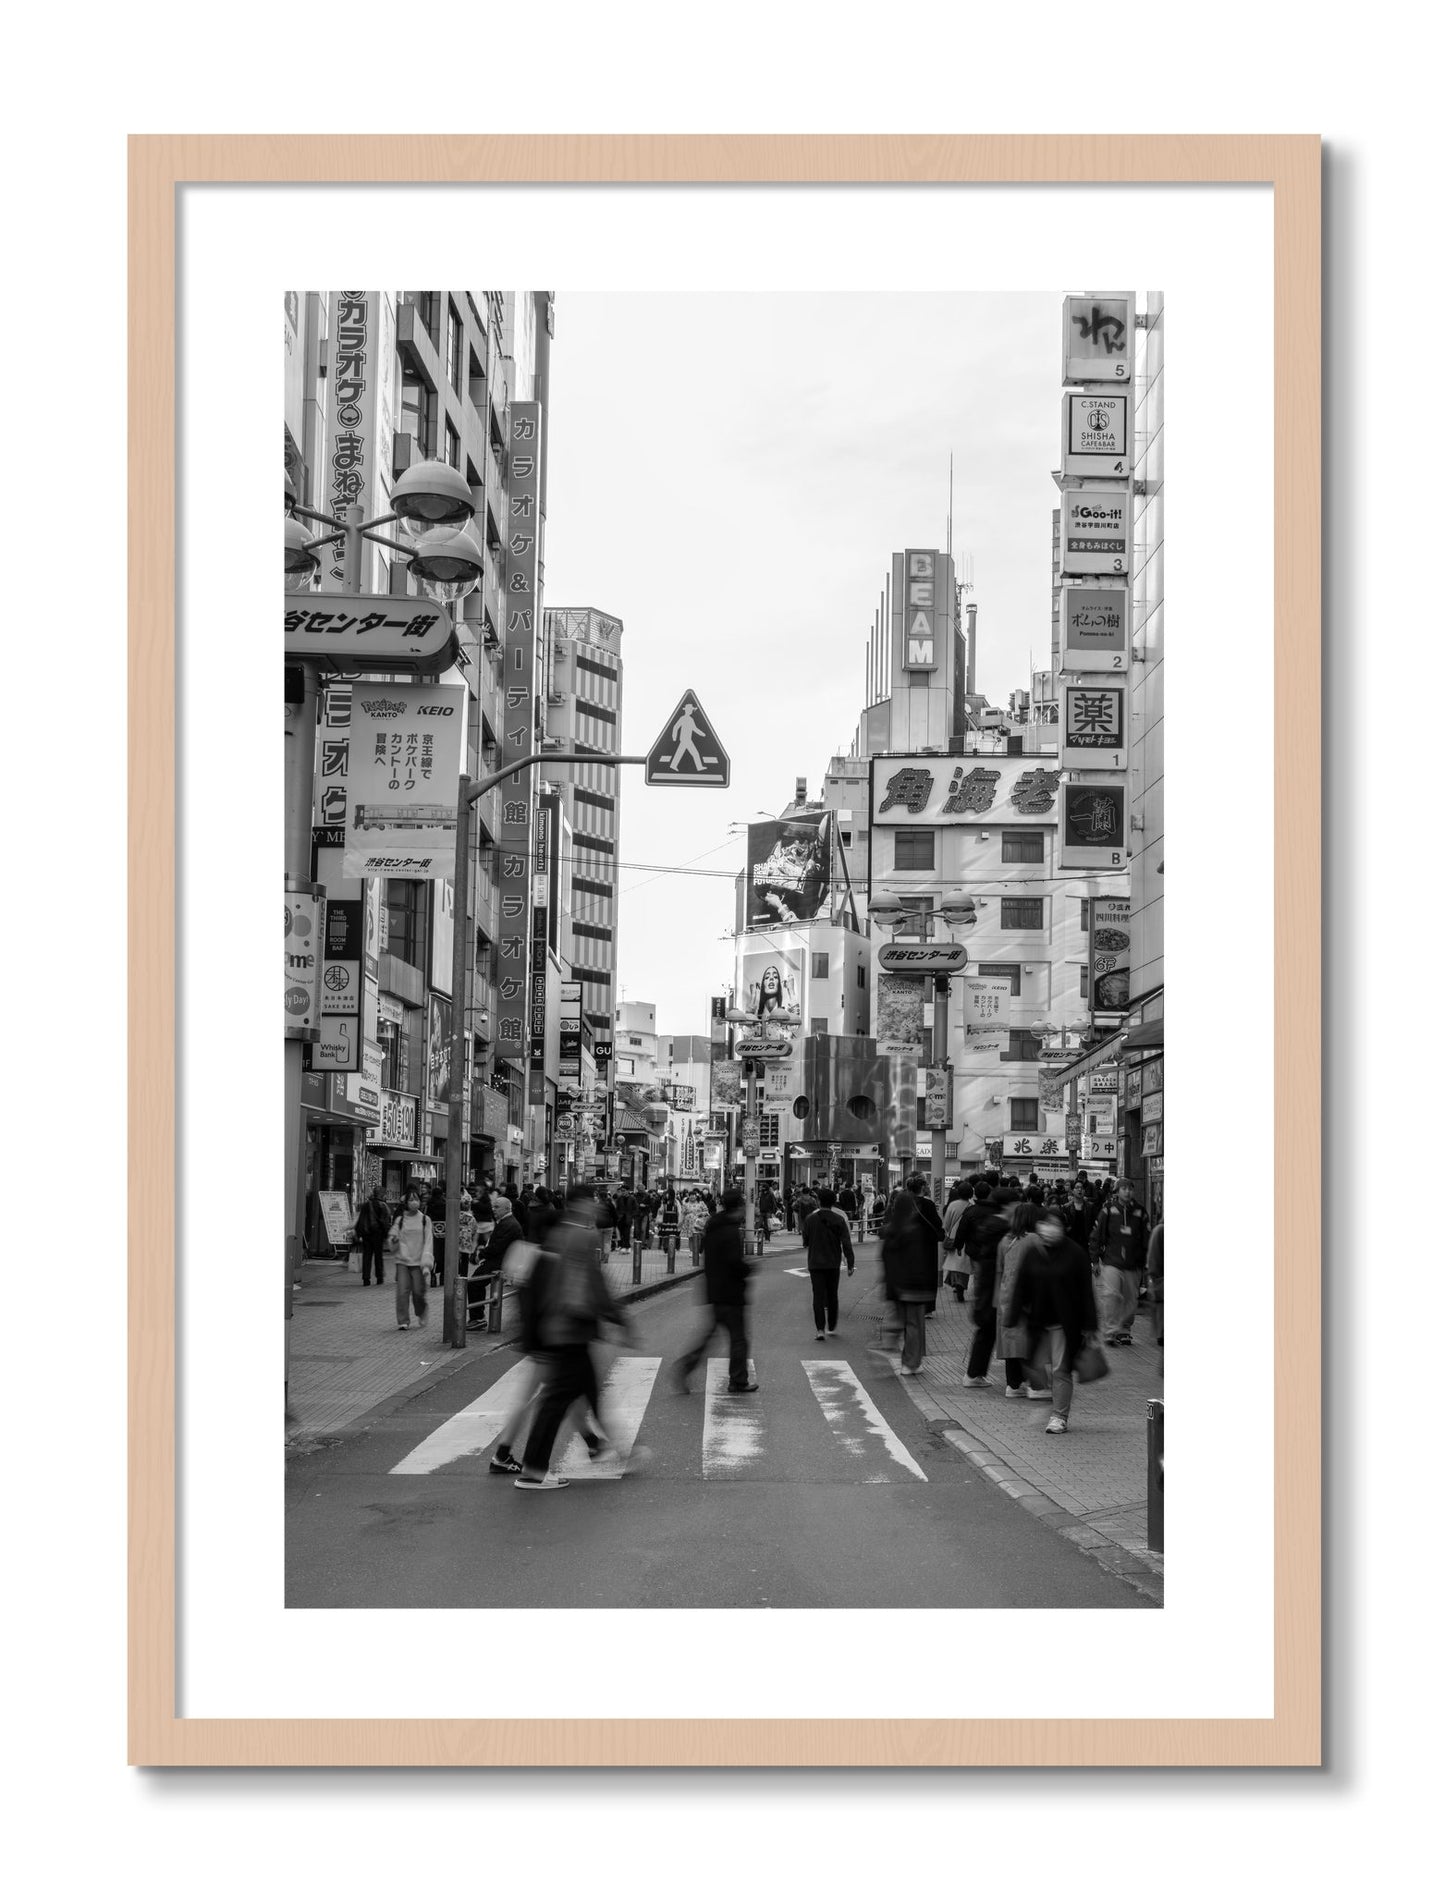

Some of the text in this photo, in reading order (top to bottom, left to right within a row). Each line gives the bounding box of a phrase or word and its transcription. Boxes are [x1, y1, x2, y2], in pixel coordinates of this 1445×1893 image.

[336, 299, 367, 405] カラオケ
[1115, 364, 1125, 377] 5
[1081, 432, 1116, 441] SHISHA
[1113, 559, 1123, 571] 3
[909, 553, 935, 664] BEAM
[1113, 656, 1122, 668] 2
[417, 705, 454, 717] KEIO
[1074, 693, 1113, 732] 薬
[375, 733, 387, 766] 冒険へ
[421, 733, 434, 780] 京王線で
[389, 733, 402, 791] カントーの
[404, 733, 418, 791] ポケパーク
[1113, 754, 1119, 766] 1
[1069, 797, 1116, 834] 一蘭
[1112, 852, 1120, 865] B
[883, 950, 963, 960] 渋谷センター街
[1094, 956, 1117, 973] 6F
[320, 1044, 347, 1053] Whisky
[596, 1046, 611, 1055] GU
[1013, 1138, 1059, 1155] 兆楽
